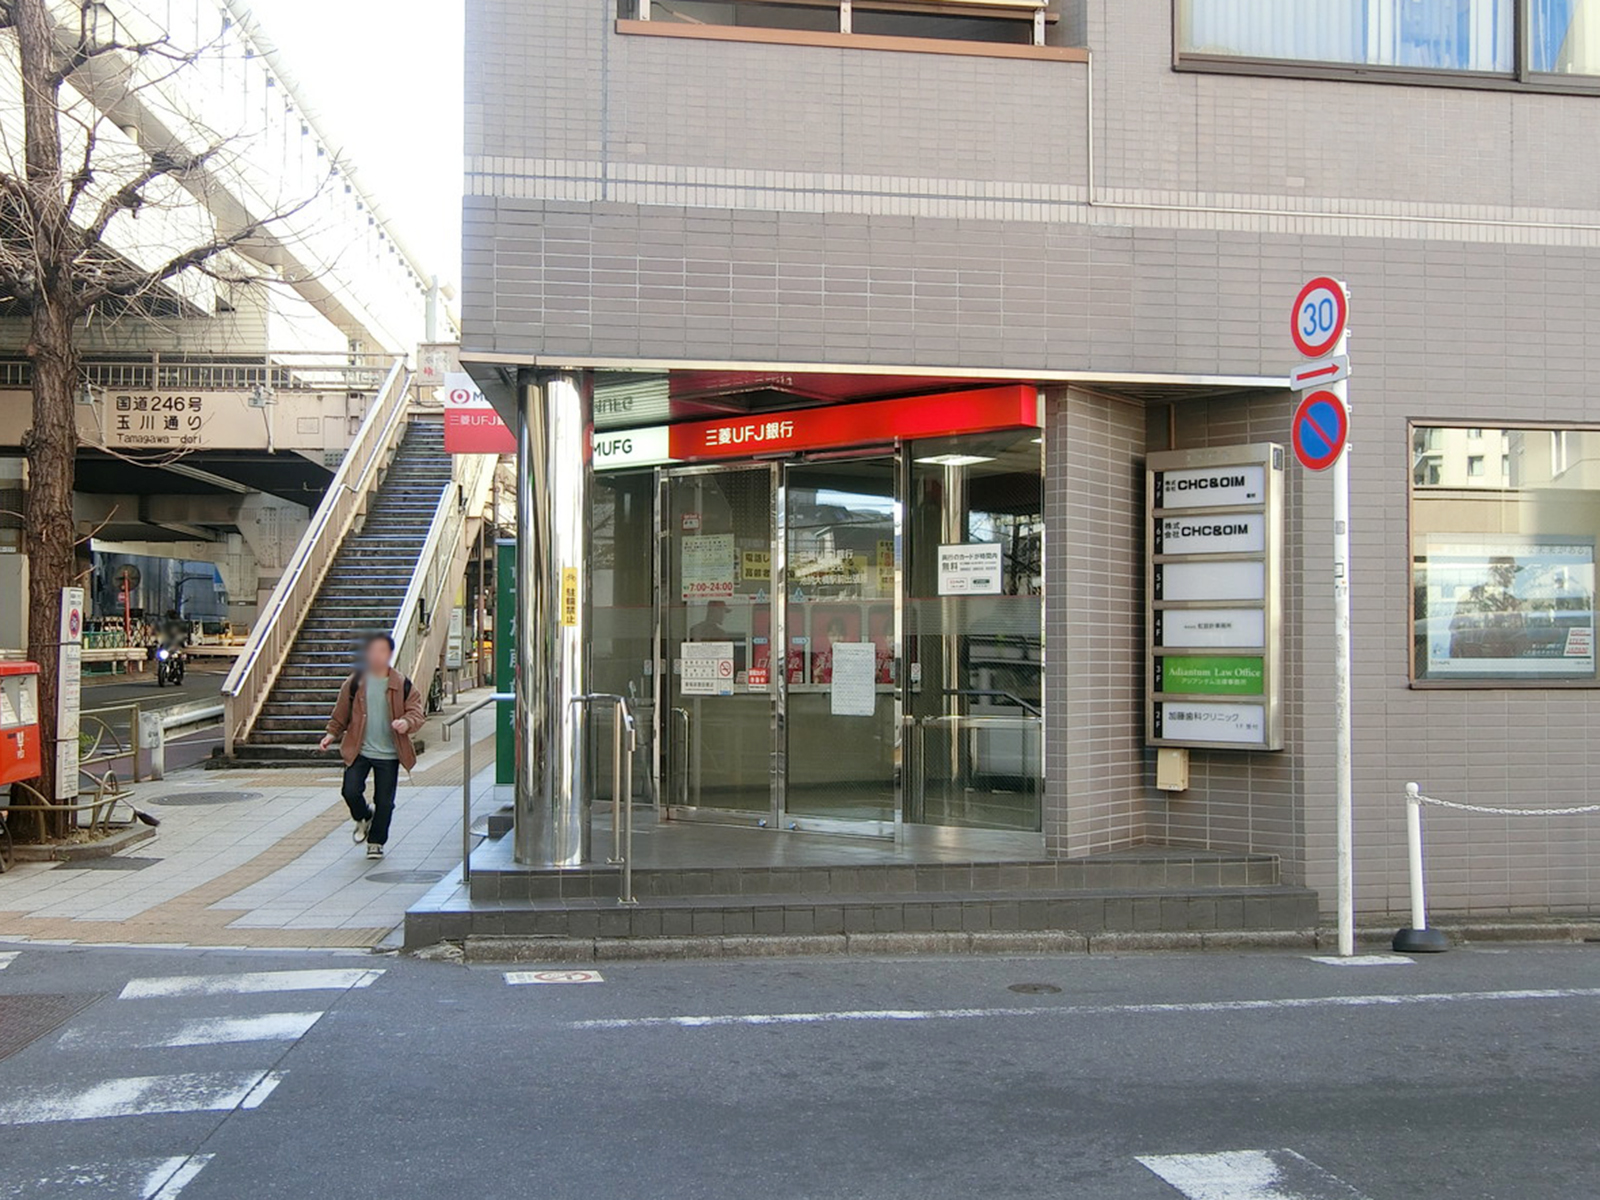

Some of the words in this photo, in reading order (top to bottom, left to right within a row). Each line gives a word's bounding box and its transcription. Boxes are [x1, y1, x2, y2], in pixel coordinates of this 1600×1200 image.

[1303, 298, 1334, 337] 30
[116, 395, 202, 412] 国道246号
[116, 414, 202, 431] 玉川通り
[116, 432, 202, 445] Tamagawa-dori
[705, 420, 794, 446] 三菱UFJ銀行
[1177, 475, 1246, 491] CHC&OIM
[1181, 523, 1249, 537] CHC&OIM
[1168, 668, 1211, 677] Adiantum
[1214, 668, 1233, 677] Law
[1234, 668, 1261, 678] Office
